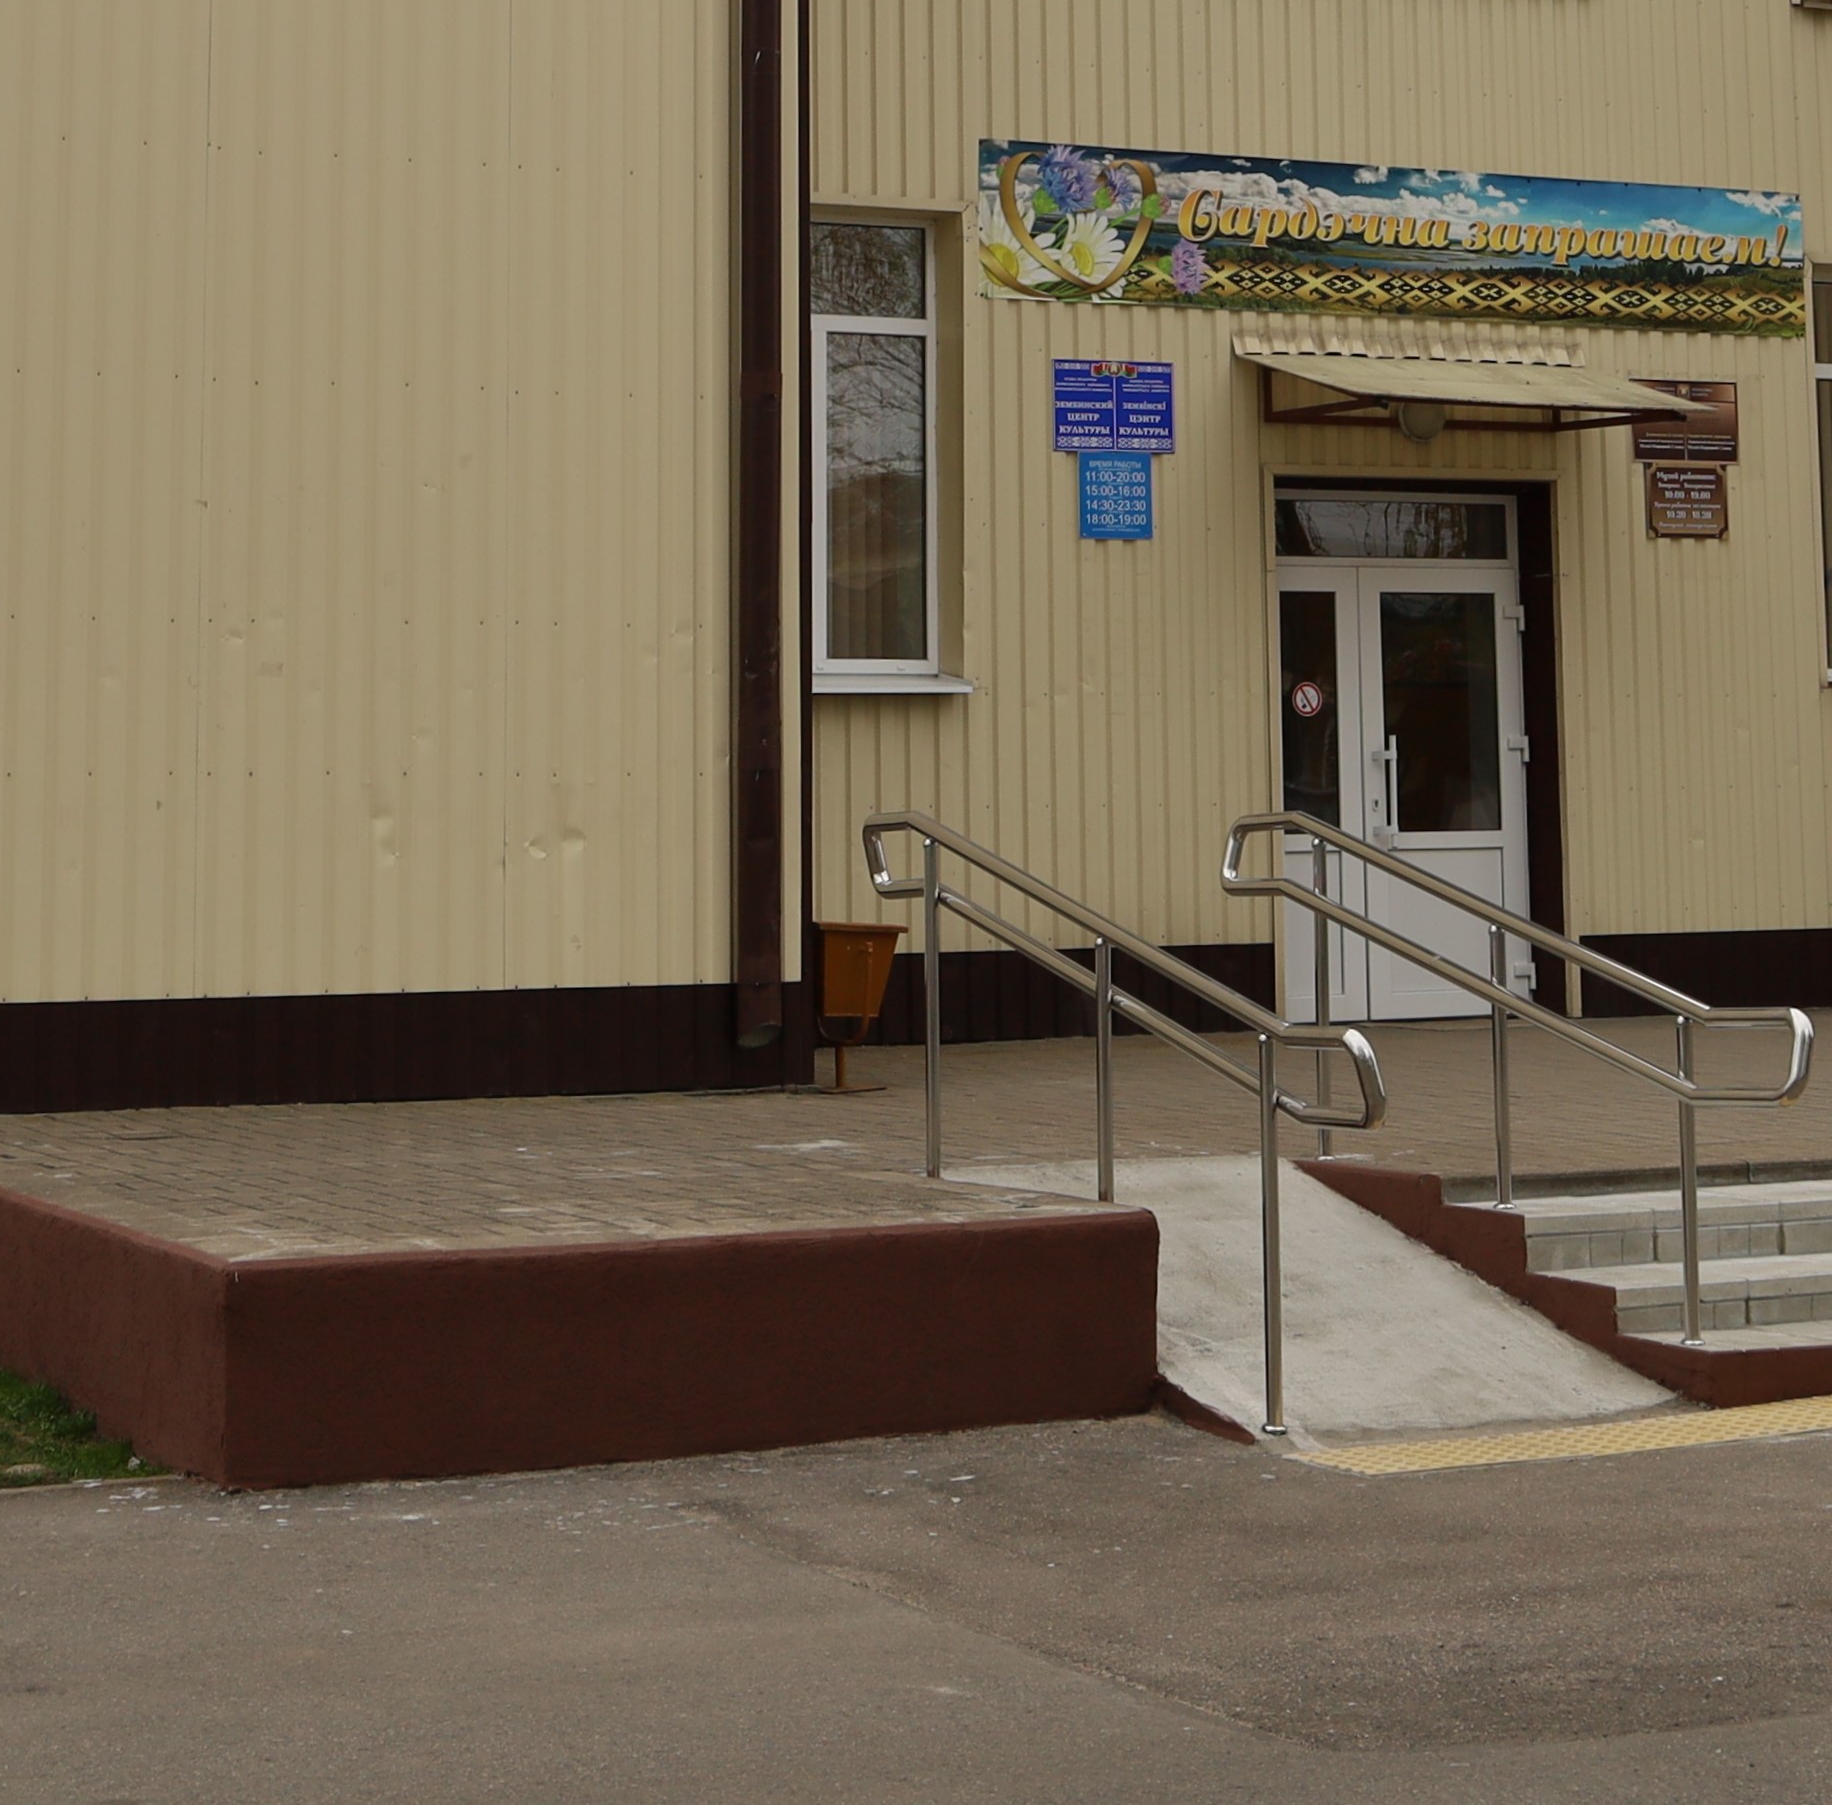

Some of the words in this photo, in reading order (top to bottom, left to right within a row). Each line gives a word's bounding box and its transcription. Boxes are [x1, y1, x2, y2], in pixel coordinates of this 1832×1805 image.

[1177, 188, 1451, 248] Сардэчна
[1461, 219, 1789, 268] запрашаем!
[1067, 413, 1100, 422] ЦЕНТР
[1129, 414, 1162, 424] ЦЭНТР
[1058, 425, 1111, 435] КУЛЬТУРЫ
[1118, 426, 1170, 436] КУЛЬТУРЫ
[1088, 460, 1113, 468] ВРЕМЯ
[1113, 460, 1142, 469] РАБОТЫ
[1085, 470, 1146, 483] 11:00-20:00
[1085, 484, 1147, 497] 15:00-16:00
[1085, 499, 1147, 512] 14:30-23:30
[1085, 513, 1148, 526] 18:00-19:00
